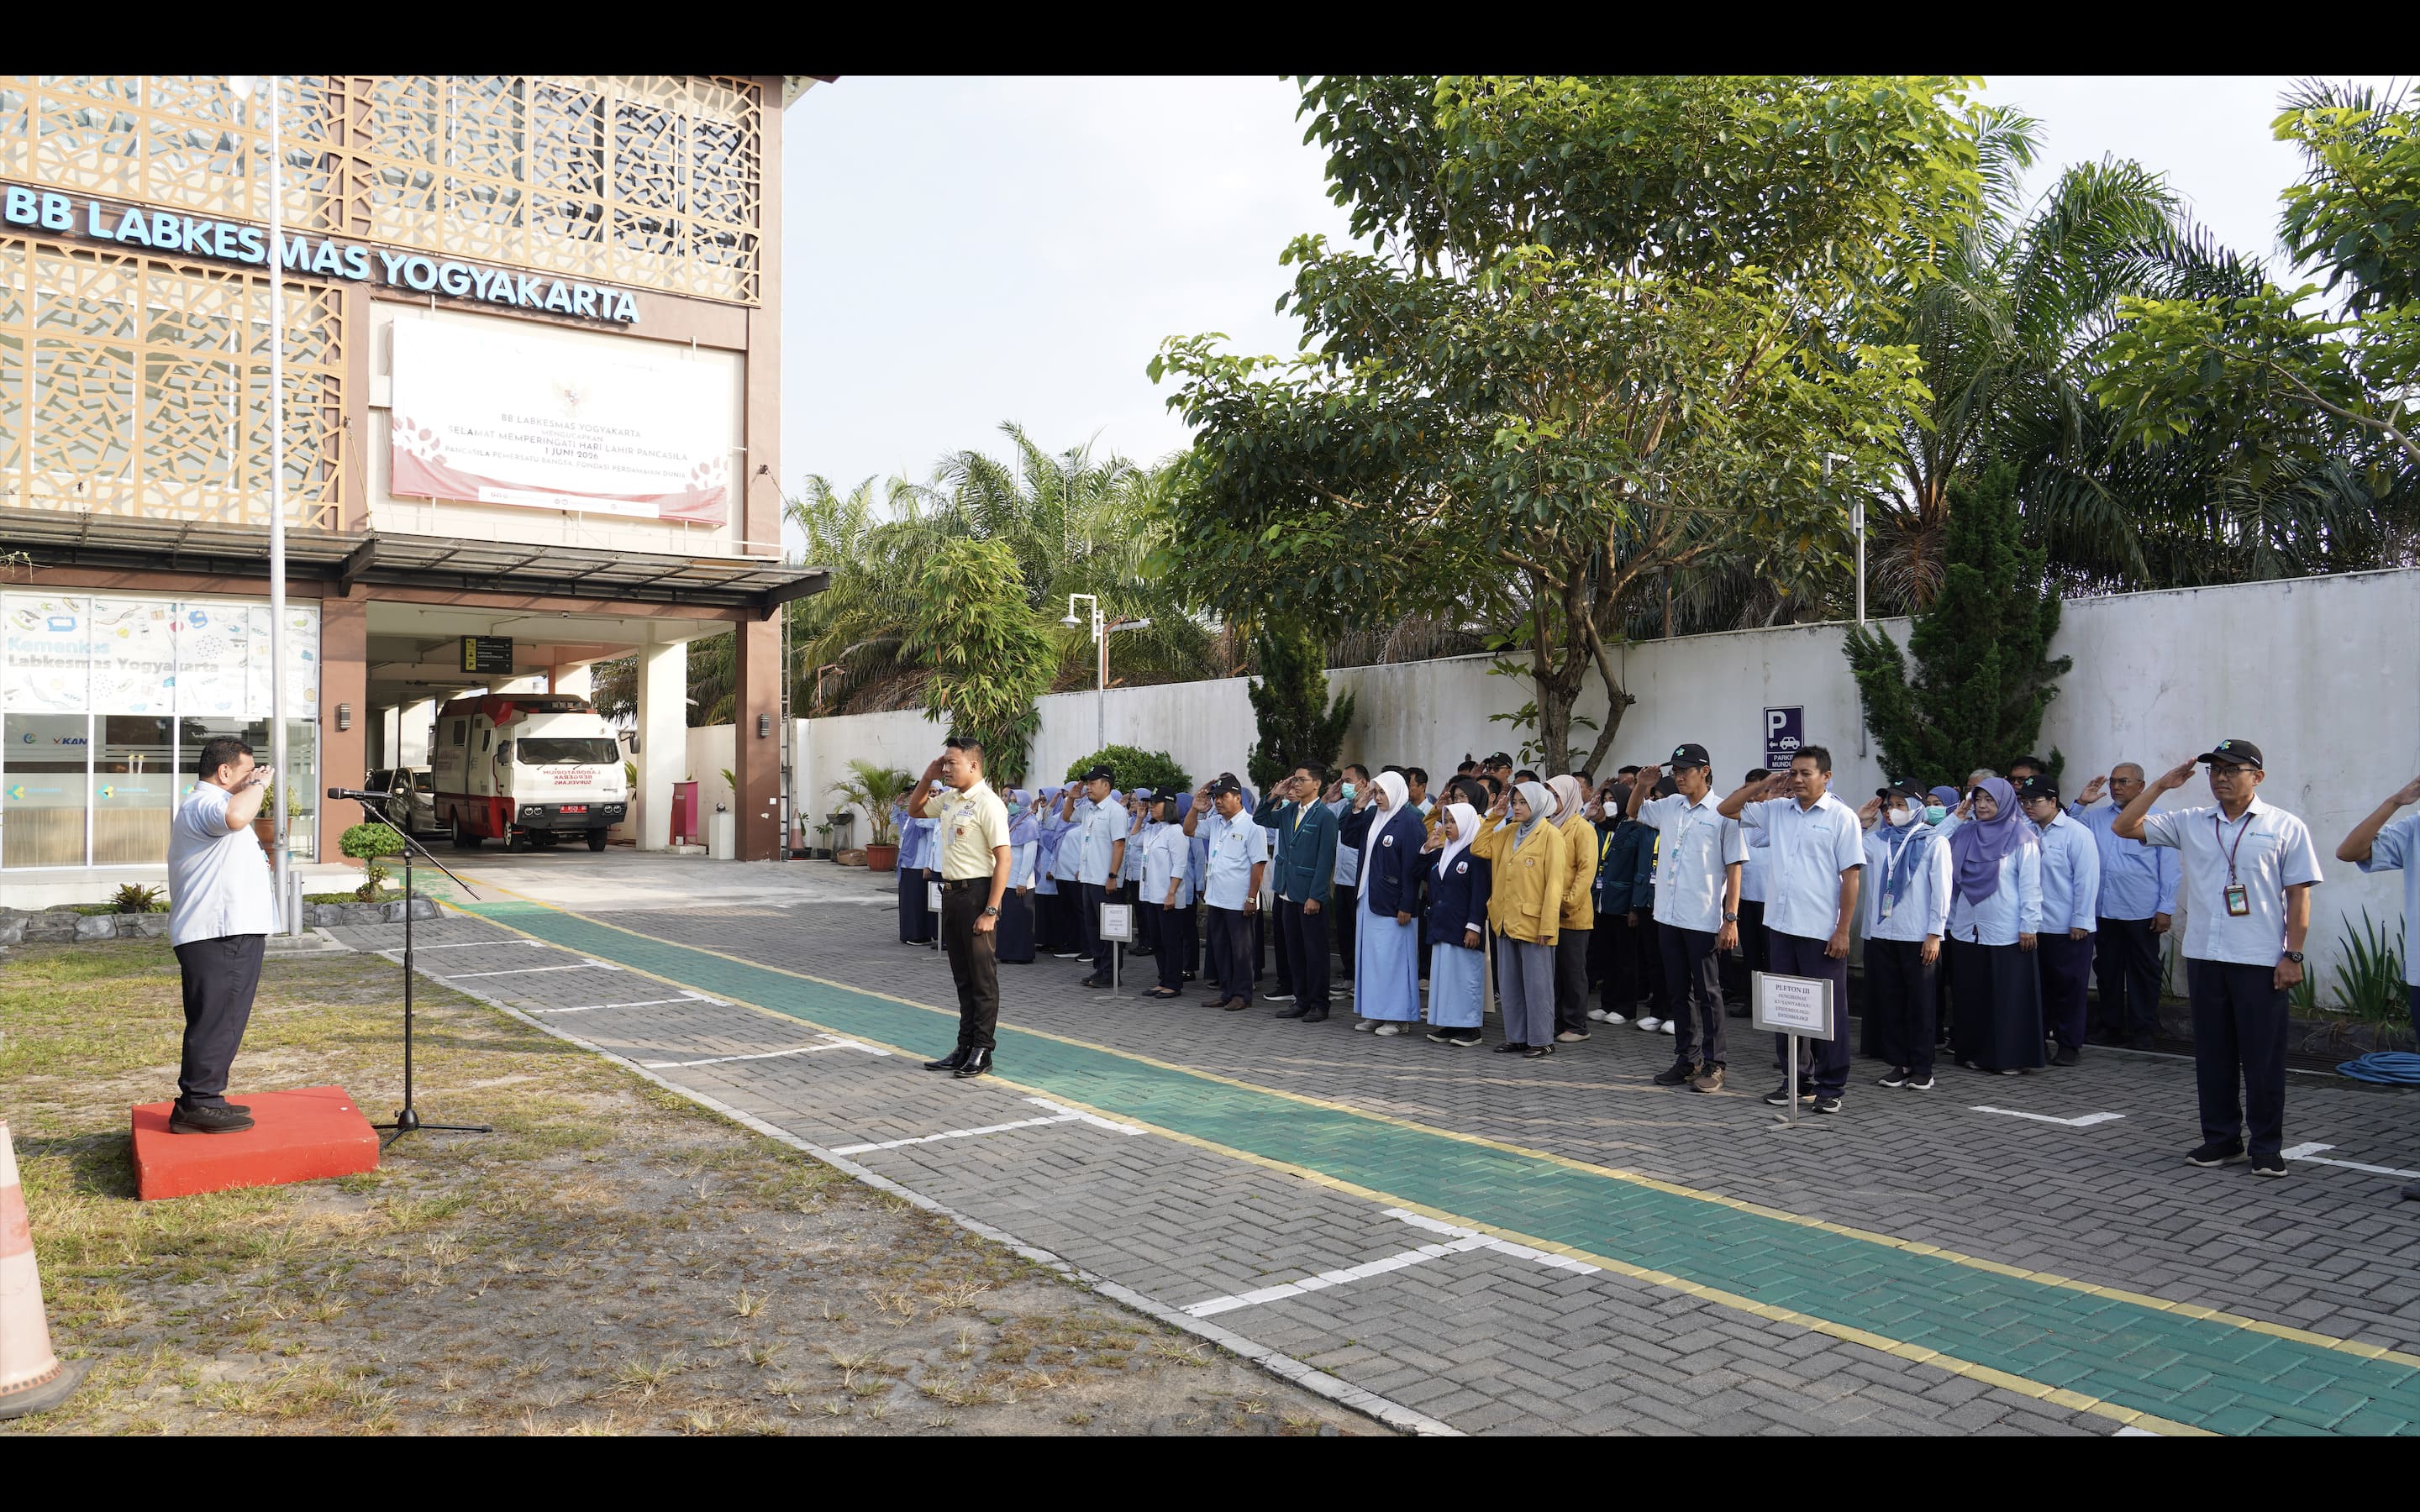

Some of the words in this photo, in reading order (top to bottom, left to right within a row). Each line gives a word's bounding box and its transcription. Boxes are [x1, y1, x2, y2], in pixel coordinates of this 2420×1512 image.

[5, 185, 75, 231] BB
[87, 201, 371, 280] LABKESMAS
[378, 249, 641, 324] YOGYAKARTA
[501, 413, 513, 423] BB
[517, 416, 576, 430] LABKESMAS
[579, 423, 641, 438] YOGYAKARTA
[541, 429, 603, 443] MENGUCAPKAN
[448, 425, 495, 438] SELAMAT
[498, 432, 576, 448] MEMPERINGATI
[579, 442, 602, 451] HARI
[605, 444, 634, 454] LAHIR
[637, 449, 688, 461] PANCASILA
[551, 447, 574, 457] JUNI
[576, 450, 599, 459] 2026
[445, 445, 490, 457] PANCASILA
[492, 451, 539, 463] PEMERSATU
[576, 461, 610, 470] FONDASI
[612, 465, 660, 476] PERDAMAIAN
[663, 470, 686, 478] DUNIA
[8, 637, 110, 654] Kemenkes
[8, 654, 112, 669] Labkesmas
[1768, 711, 1786, 738] P
[1776, 984, 1802, 993] PLETON
